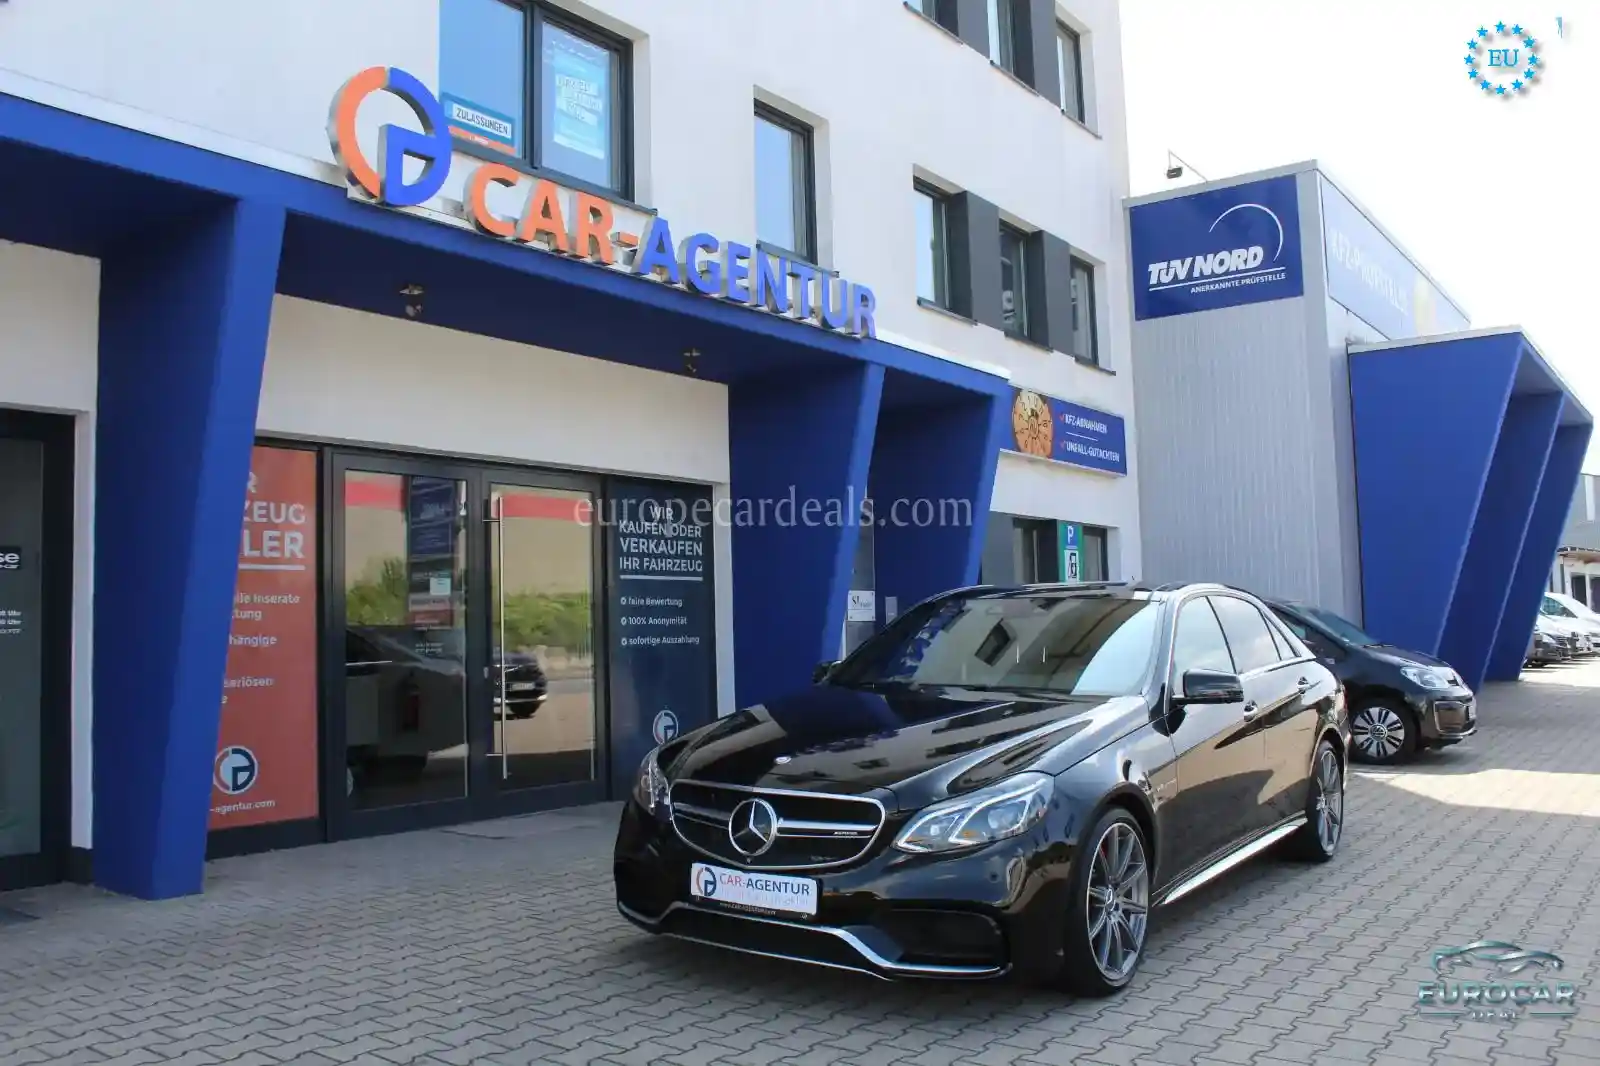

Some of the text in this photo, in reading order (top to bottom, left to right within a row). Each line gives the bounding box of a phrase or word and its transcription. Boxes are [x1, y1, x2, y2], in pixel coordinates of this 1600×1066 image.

[456, 107, 509, 136] ZULASSUNGEN
[462, 161, 877, 338] CAR-AGENTUR
[1148, 245, 1264, 285] TÜV NORD
[1190, 271, 1286, 294] ANERKANNTE PRÜFSTELLE
[1064, 413, 1108, 434] KFZ-ABNAHMEN
[1065, 441, 1120, 463] UNFALL-GUTACHTEN
[649, 504, 674, 520] WIR
[619, 520, 702, 538] KAUFEN ODER
[1067, 525, 1074, 545] P
[619, 537, 703, 556] VERKAUFEN
[619, 556, 703, 572] IHR FAHRZEUG
[628, 596, 683, 608] faire Bewertung
[628, 615, 688, 627] 100% Anonymität
[628, 635, 700, 647] sofortige Auszahlung
[719, 872, 811, 897] CAR-AGENTUR
